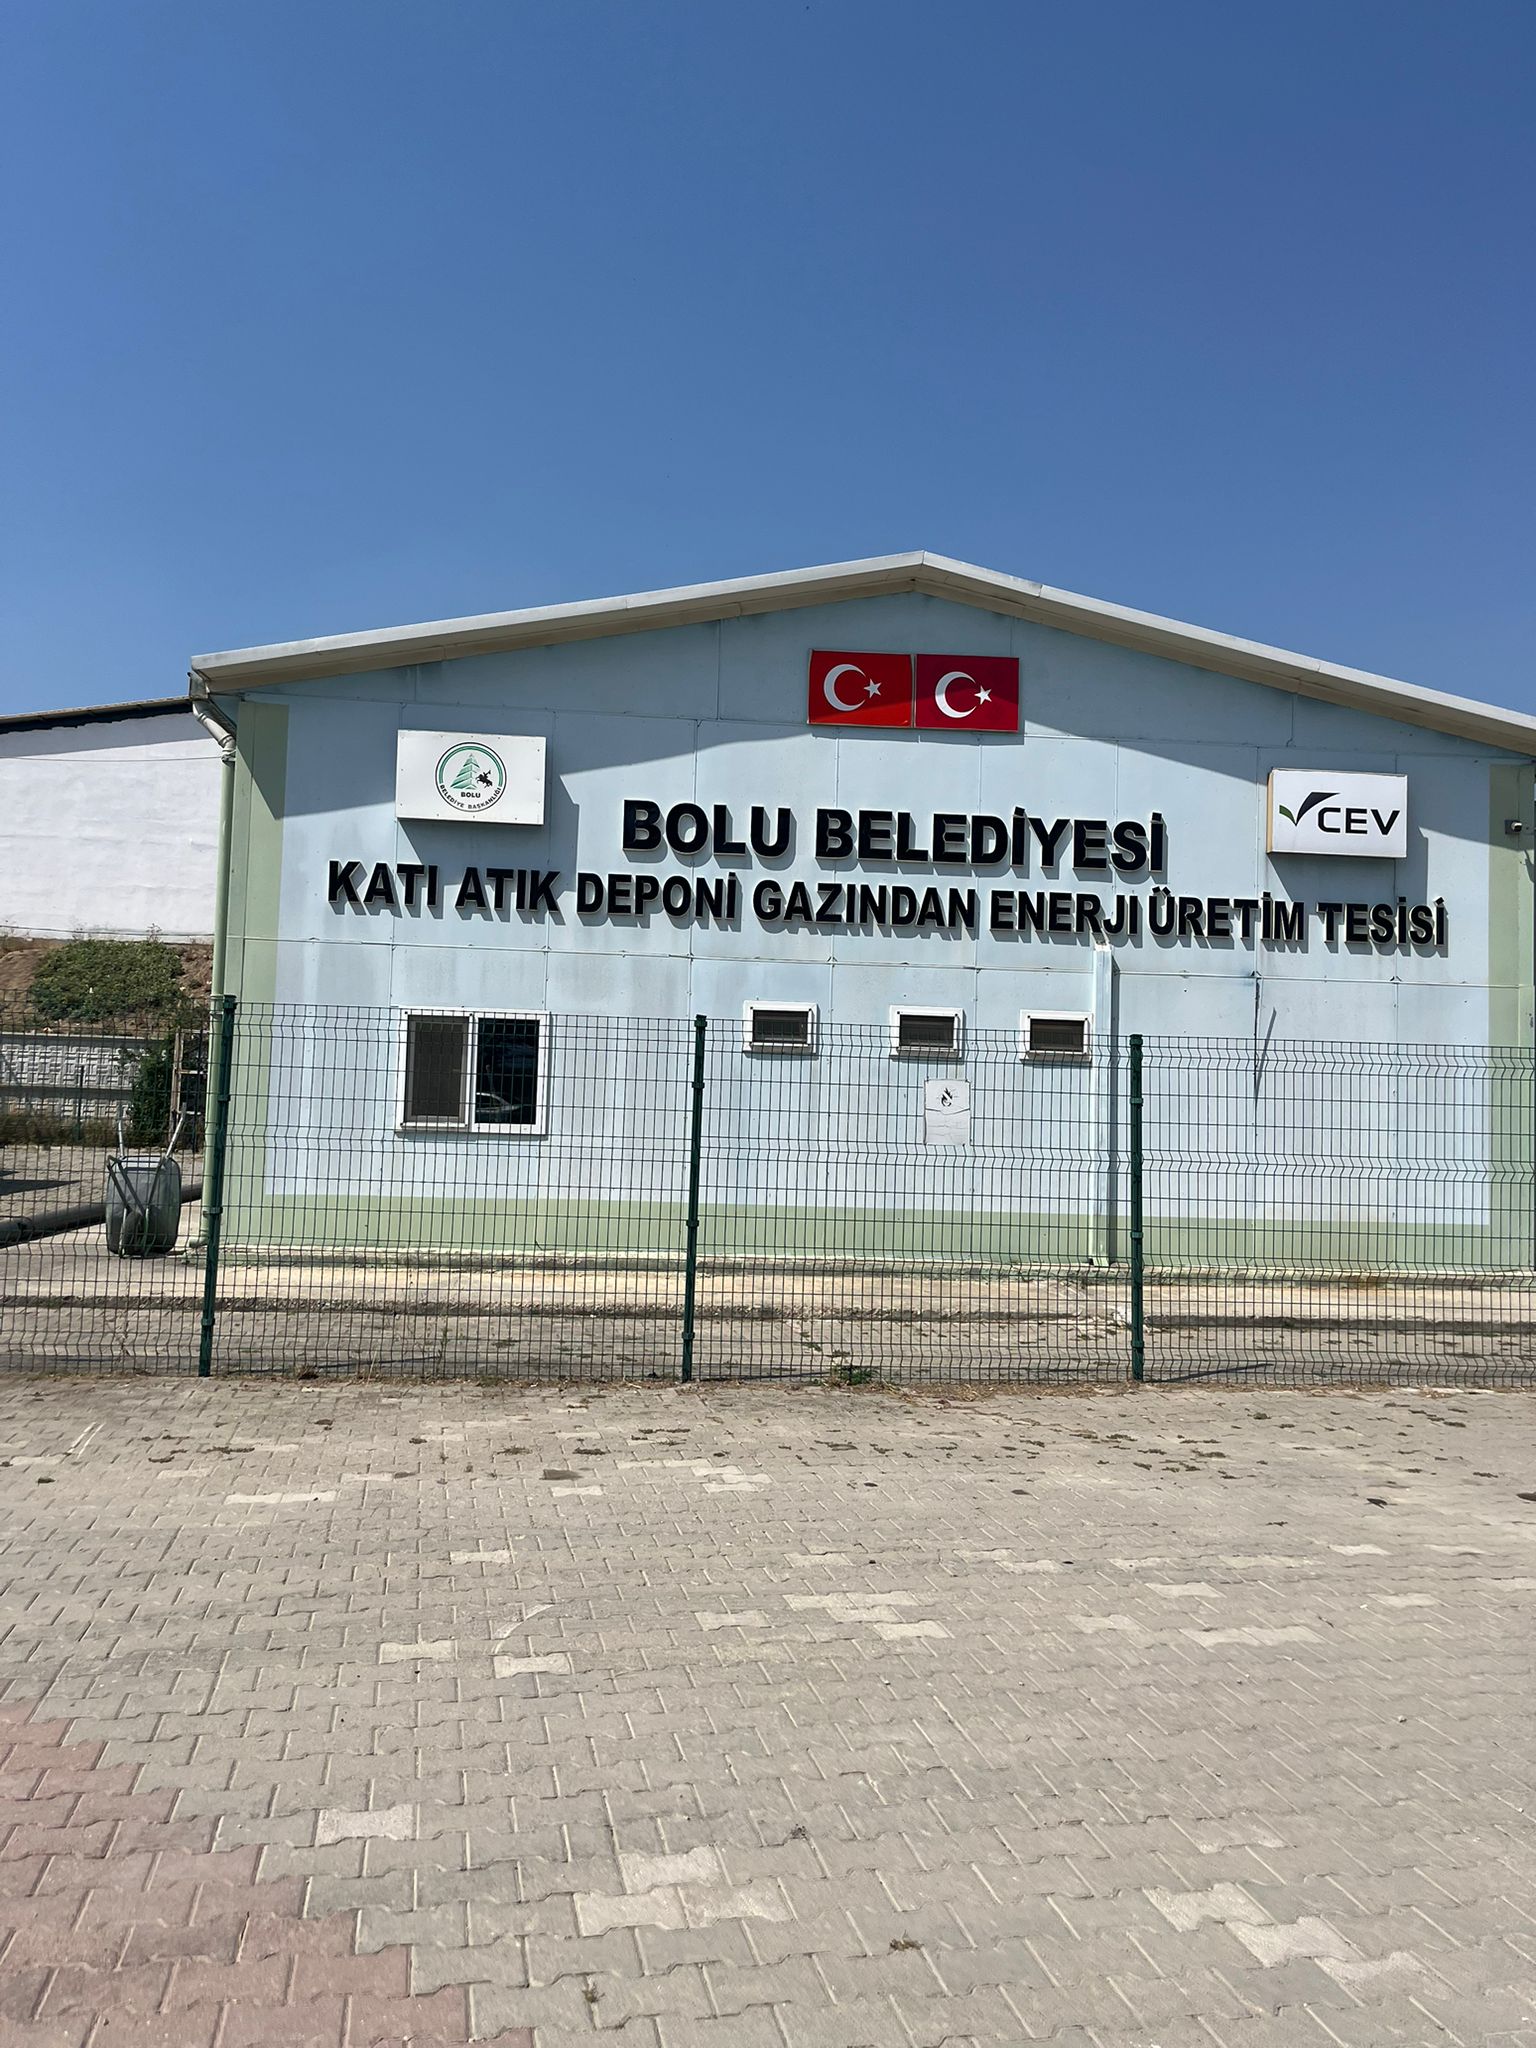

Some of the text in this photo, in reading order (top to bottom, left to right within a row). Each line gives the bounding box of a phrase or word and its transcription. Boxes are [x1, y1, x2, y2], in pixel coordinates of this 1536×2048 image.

[622, 799, 1163, 872] BOLU BELEDİYESİ
[1316, 806, 1400, 836] CEV
[328, 860, 437, 906] KATI
[455, 866, 560, 912] ATIK
[577, 871, 737, 919] DEPONİ
[752, 879, 976, 929] GAZINDAN
[1148, 885, 1305, 942] ÜRETİM
[1317, 896, 1445, 946] TESİSİ
